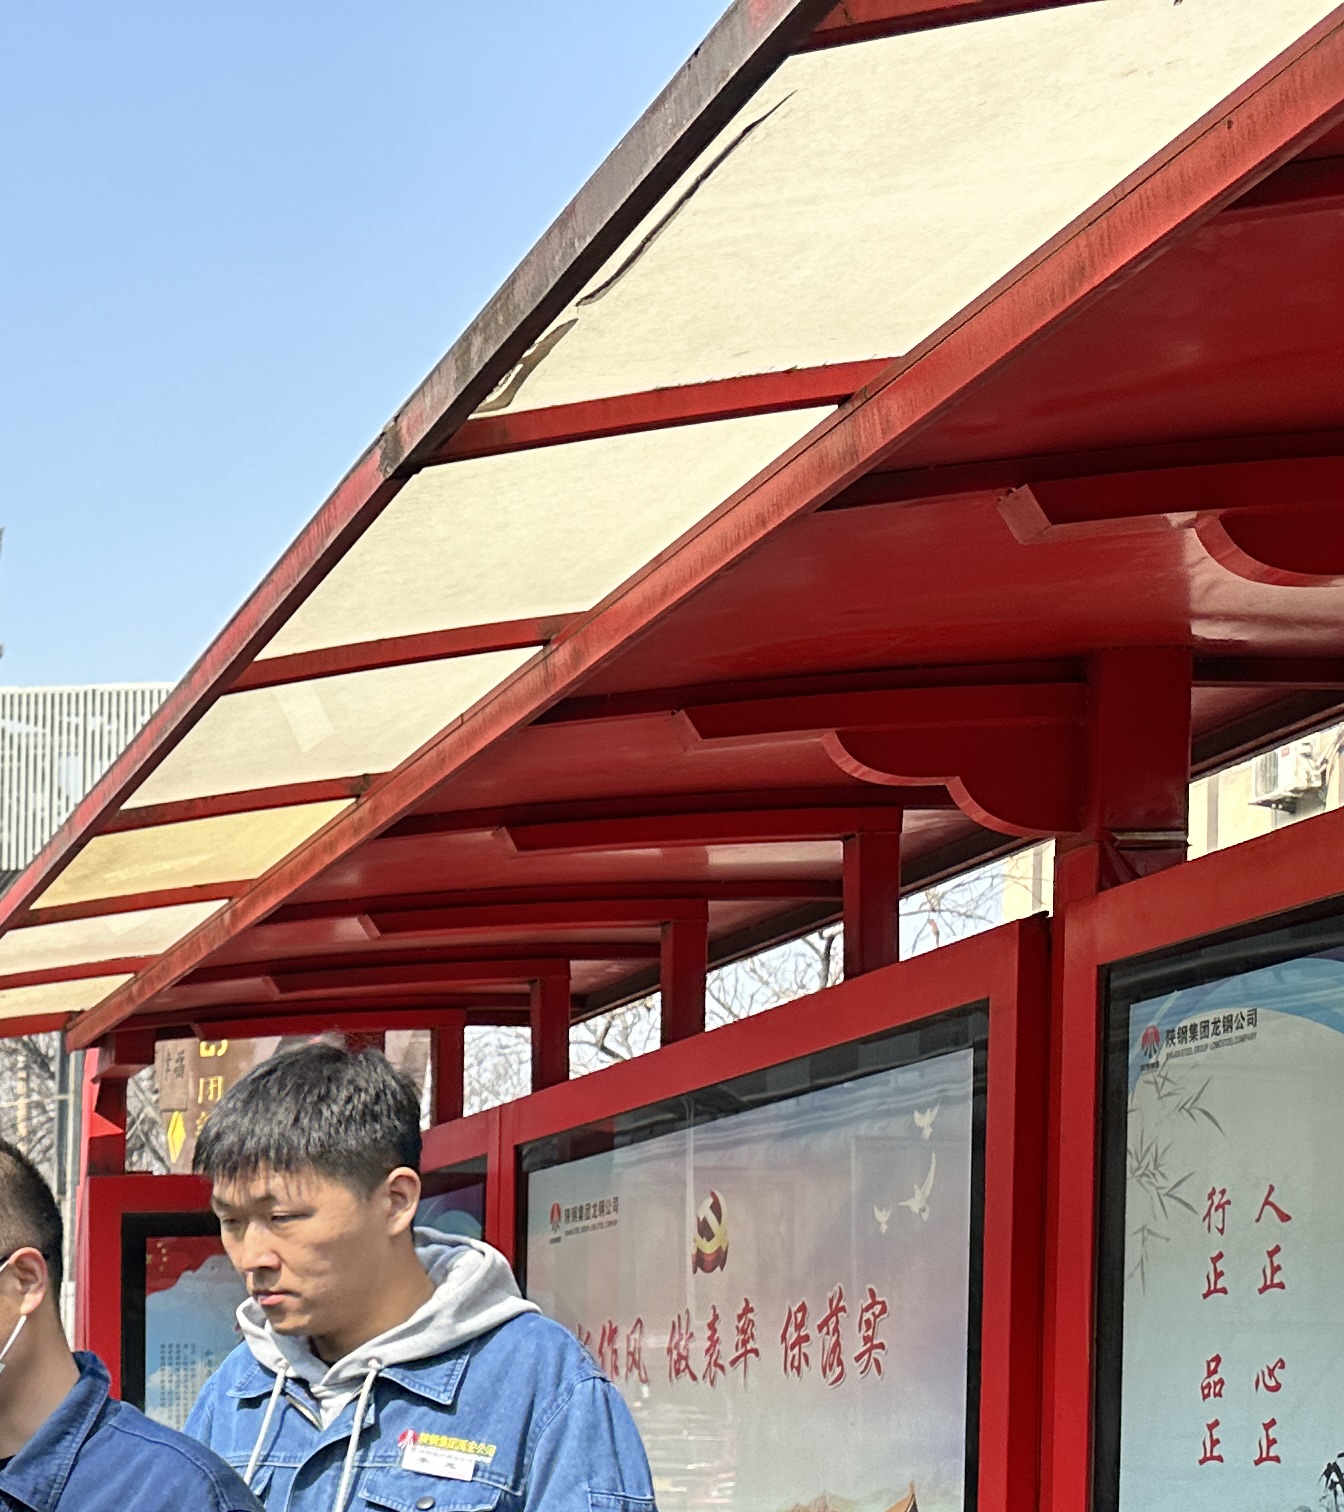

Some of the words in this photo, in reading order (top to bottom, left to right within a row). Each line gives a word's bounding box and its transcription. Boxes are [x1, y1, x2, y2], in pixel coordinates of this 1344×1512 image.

[1202, 1186, 1232, 1300] 行正
[1254, 1184, 1293, 1295] 人正
[577, 1317, 649, 1386] 作风
[666, 1297, 760, 1391] 做表率
[780, 1284, 888, 1386] 保落实
[1198, 1353, 1226, 1466] 品正
[1253, 1357, 1286, 1466] 心正
